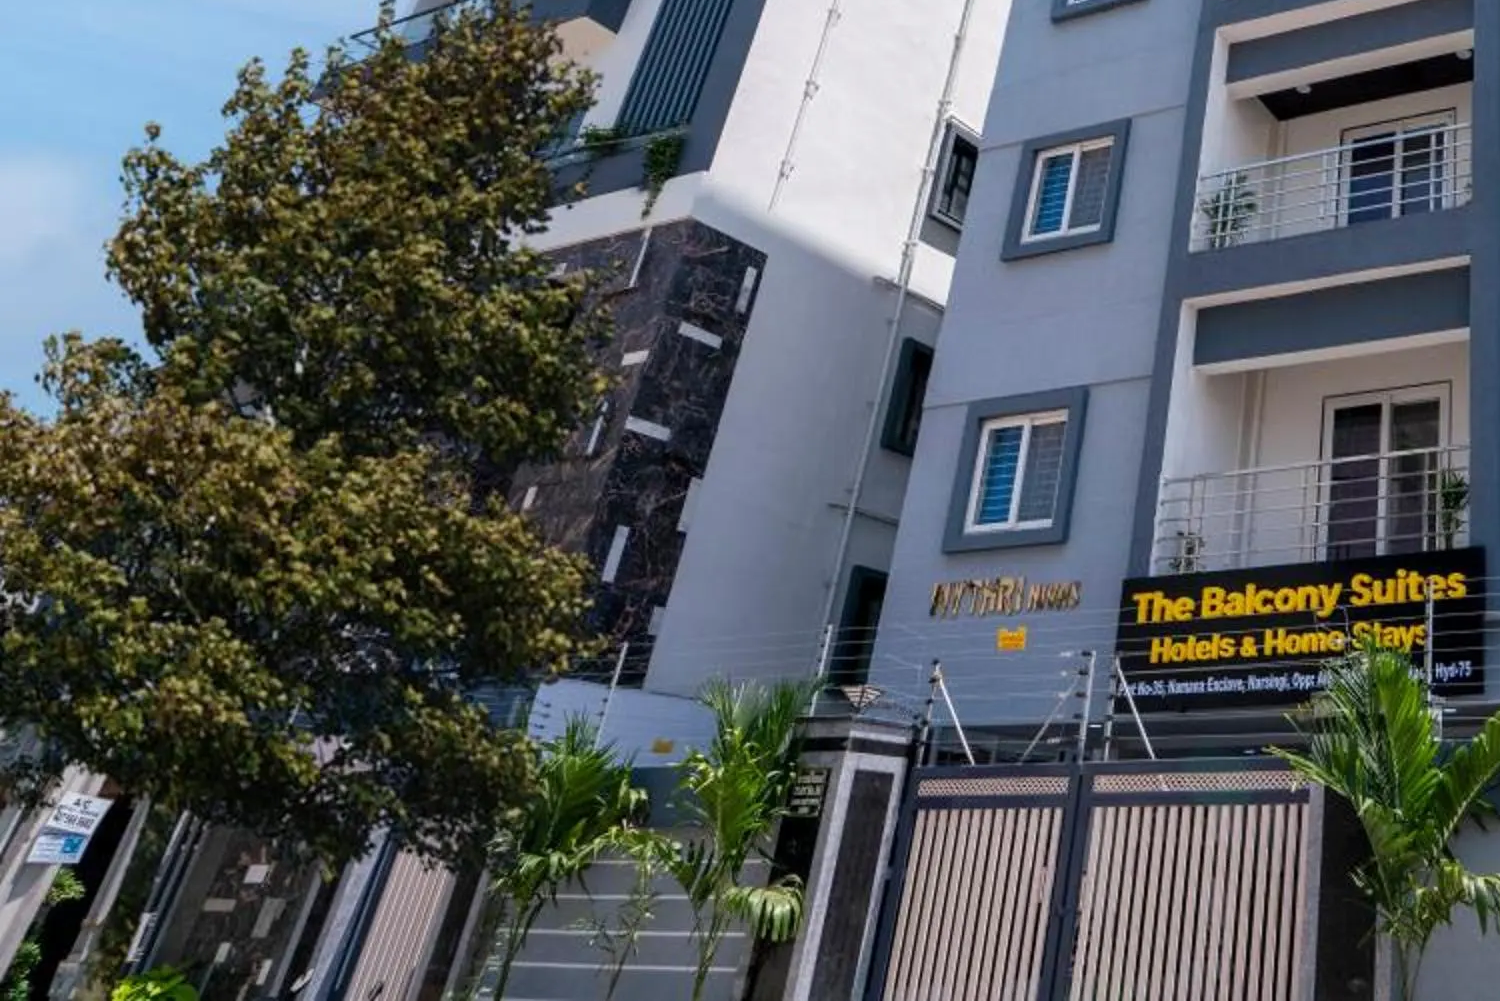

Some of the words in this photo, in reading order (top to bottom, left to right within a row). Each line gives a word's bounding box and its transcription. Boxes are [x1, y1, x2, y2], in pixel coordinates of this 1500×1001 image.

[1133, 591, 1195, 625] The
[1200, 580, 1343, 620] Balcony
[1350, 569, 1467, 607] Suites
[1150, 633, 1237, 664] Hotels
[1239, 636, 1257, 658] &
[1264, 627, 1345, 657] Home
[1351, 621, 1427, 654] Stays
